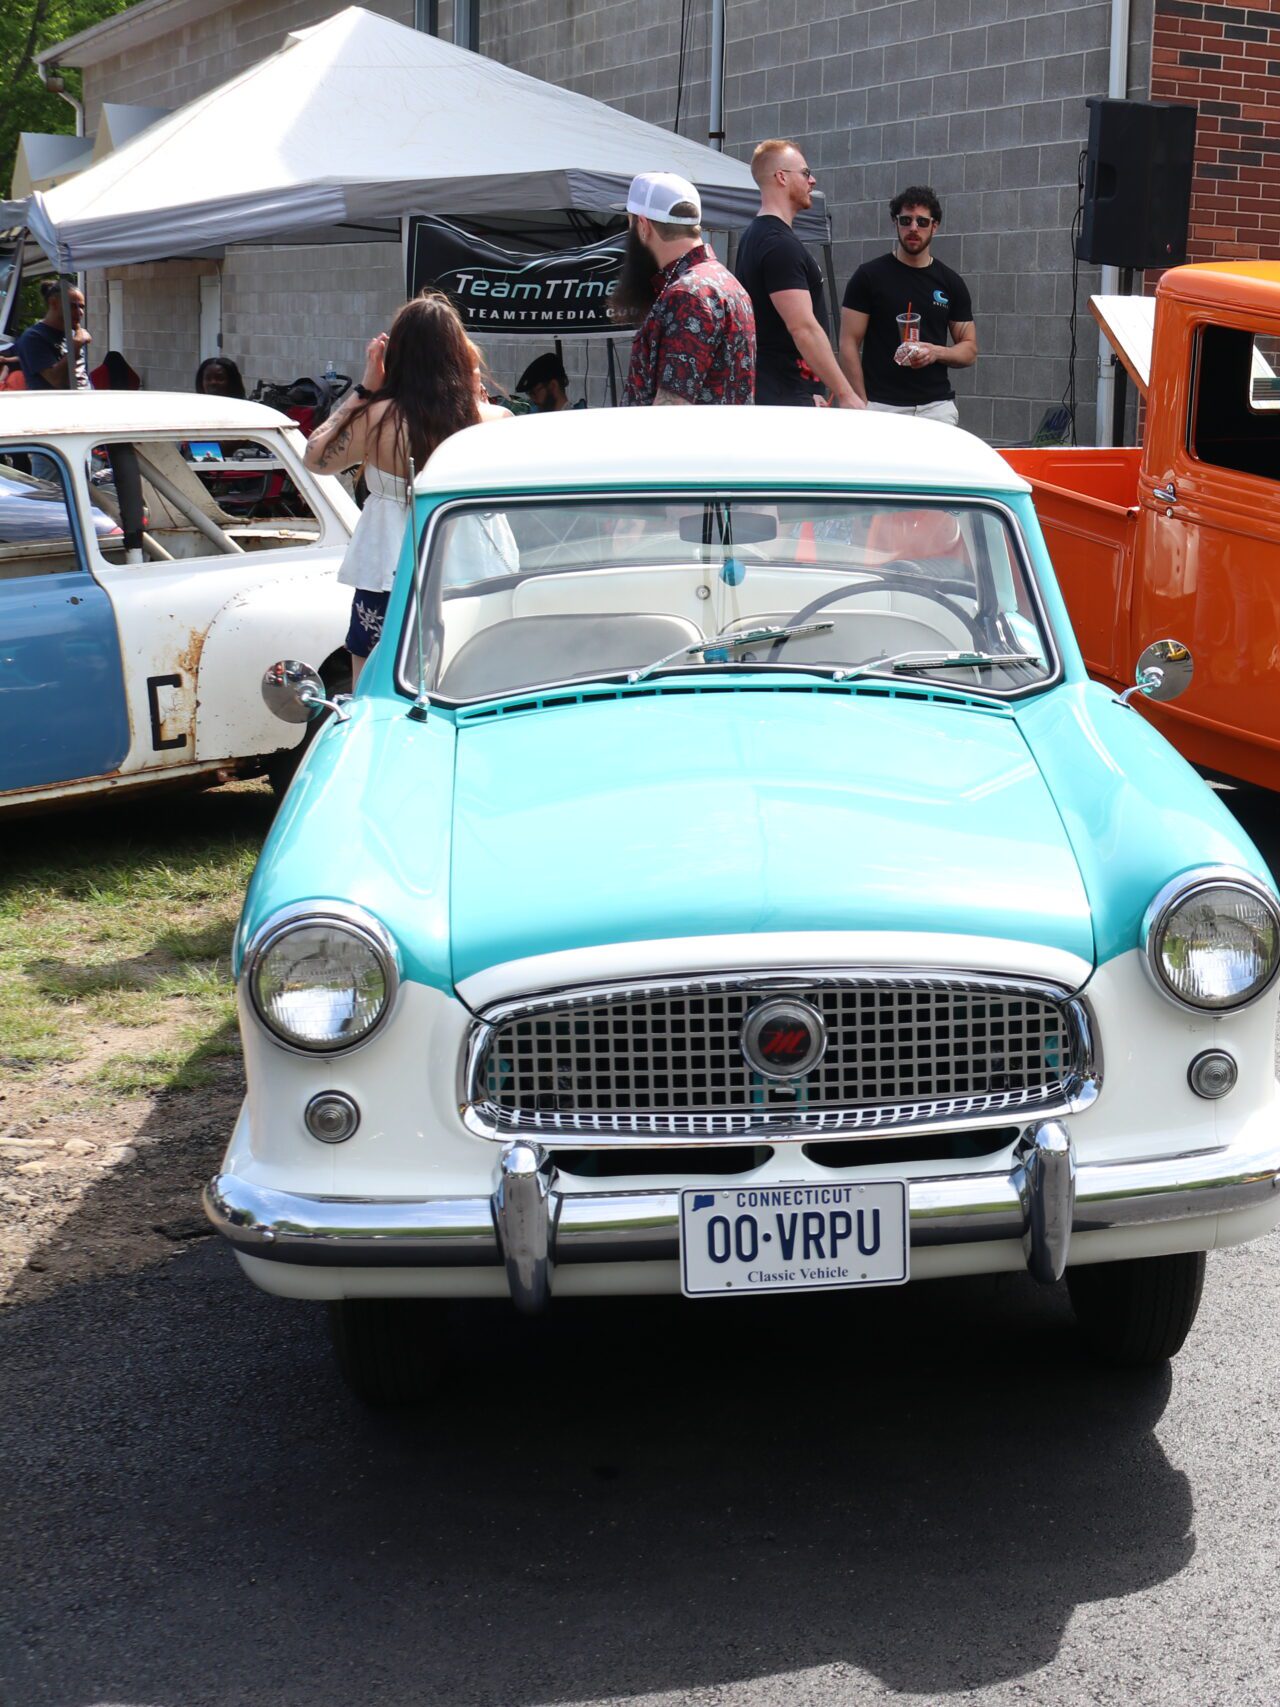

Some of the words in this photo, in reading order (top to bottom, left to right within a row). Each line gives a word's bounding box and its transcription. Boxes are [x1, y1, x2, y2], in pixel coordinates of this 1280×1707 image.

[736, 1188, 852, 1208] CONNECTICUT
[748, 1269, 796, 1283] Classic
[800, 1266, 849, 1280] Vehicle
